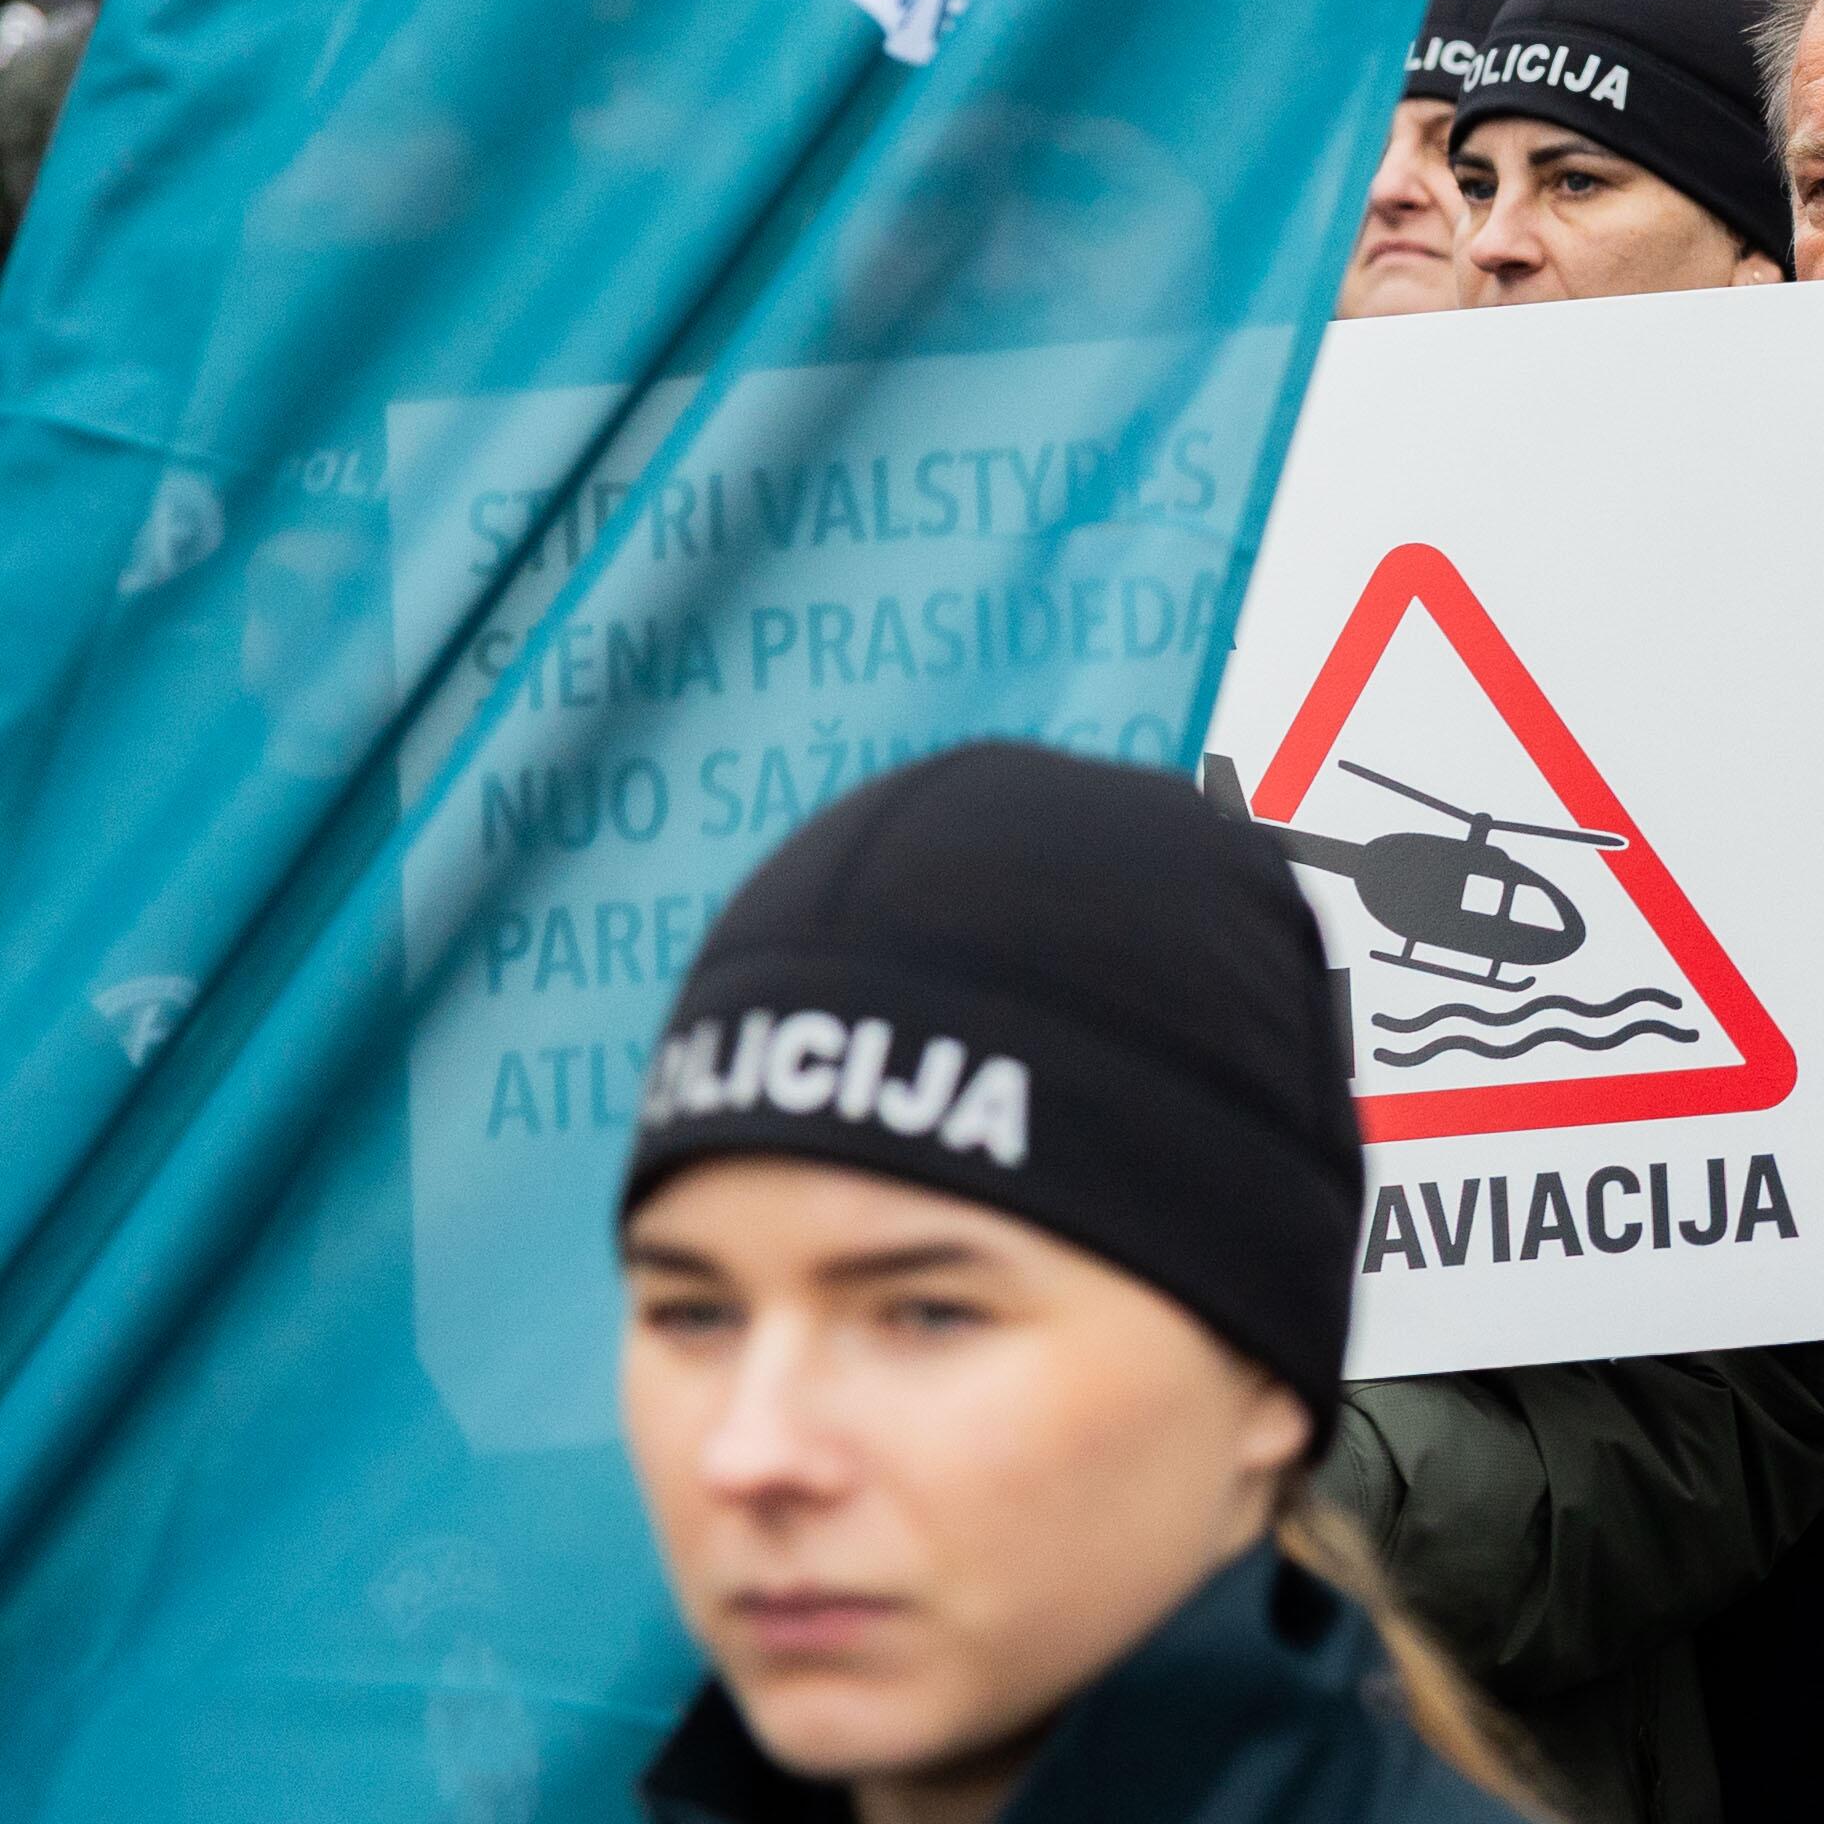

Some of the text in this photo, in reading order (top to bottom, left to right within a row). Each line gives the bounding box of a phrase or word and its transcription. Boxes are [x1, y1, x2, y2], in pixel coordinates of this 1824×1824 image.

[750, 428, 1218, 552] VALSTYS
[479, 755, 670, 854] NUO
[486, 890, 722, 996] PARE
[1362, 1152, 1799, 1275] AVIACIJA
